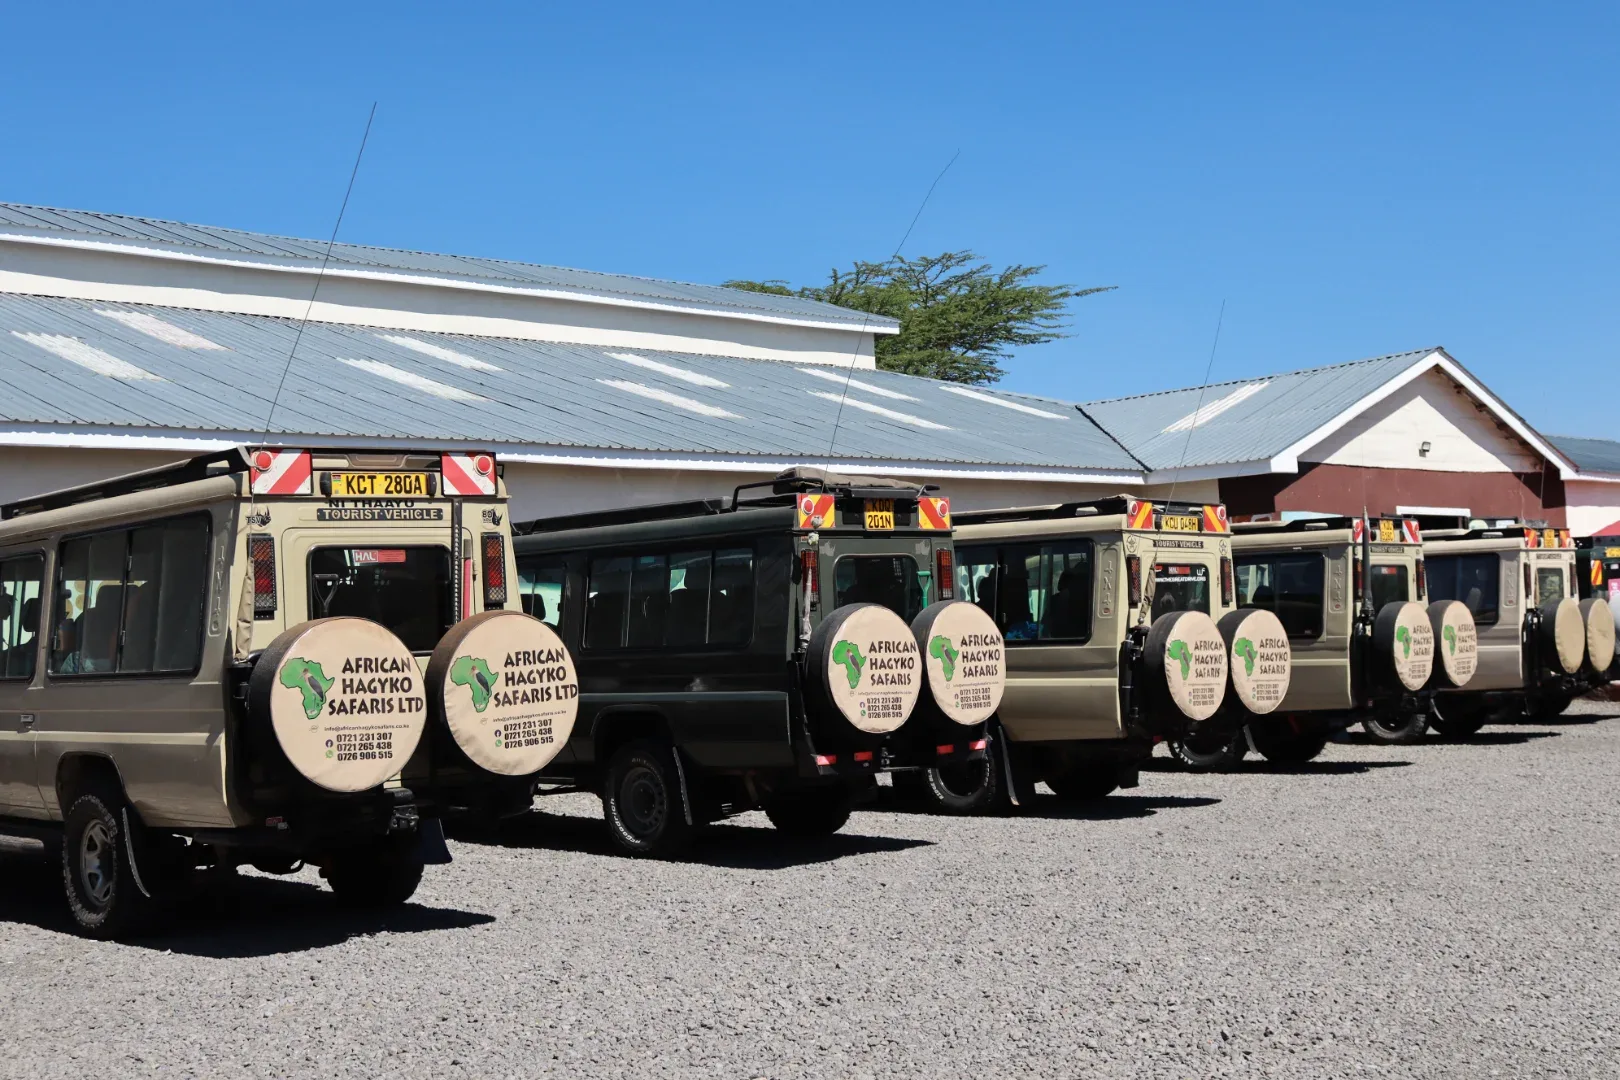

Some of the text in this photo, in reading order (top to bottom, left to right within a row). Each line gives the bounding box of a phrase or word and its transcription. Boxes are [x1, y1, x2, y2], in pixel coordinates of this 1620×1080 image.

[346, 475, 423, 495] KCT 280A
[329, 499, 345, 508] NI
[323, 509, 438, 520] TOURIST VEHICLE
[868, 514, 892, 529] 201N
[1155, 540, 1179, 548] TOURIST
[868, 641, 917, 654] AFRICAN
[960, 634, 1001, 648] AFRICAN
[503, 647, 566, 668] AFRICAN
[869, 656, 915, 671] HAGYKO
[961, 649, 1001, 664] HAGYKO
[342, 657, 412, 675] AFRICAN
[962, 664, 999, 679] SAFARIS
[1195, 667, 1221, 679] SAFARIS
[1260, 664, 1286, 675] SAFARIS
[504, 665, 567, 687] HAGYKO
[870, 673, 912, 687] SAFARIS
[342, 676, 413, 695] HAGYKO
[493, 684, 578, 708] SAFARIS LTD
[328, 697, 424, 716] SAFARIS LTD
[503, 719, 552, 732] 0721 231 307
[336, 732, 393, 743] 0721 231 307
[504, 727, 553, 741] 0721 265 438
[337, 741, 392, 752] 0721 265 438
[504, 735, 554, 749] 0726 906 515
[337, 750, 393, 762] 0726 906 515
